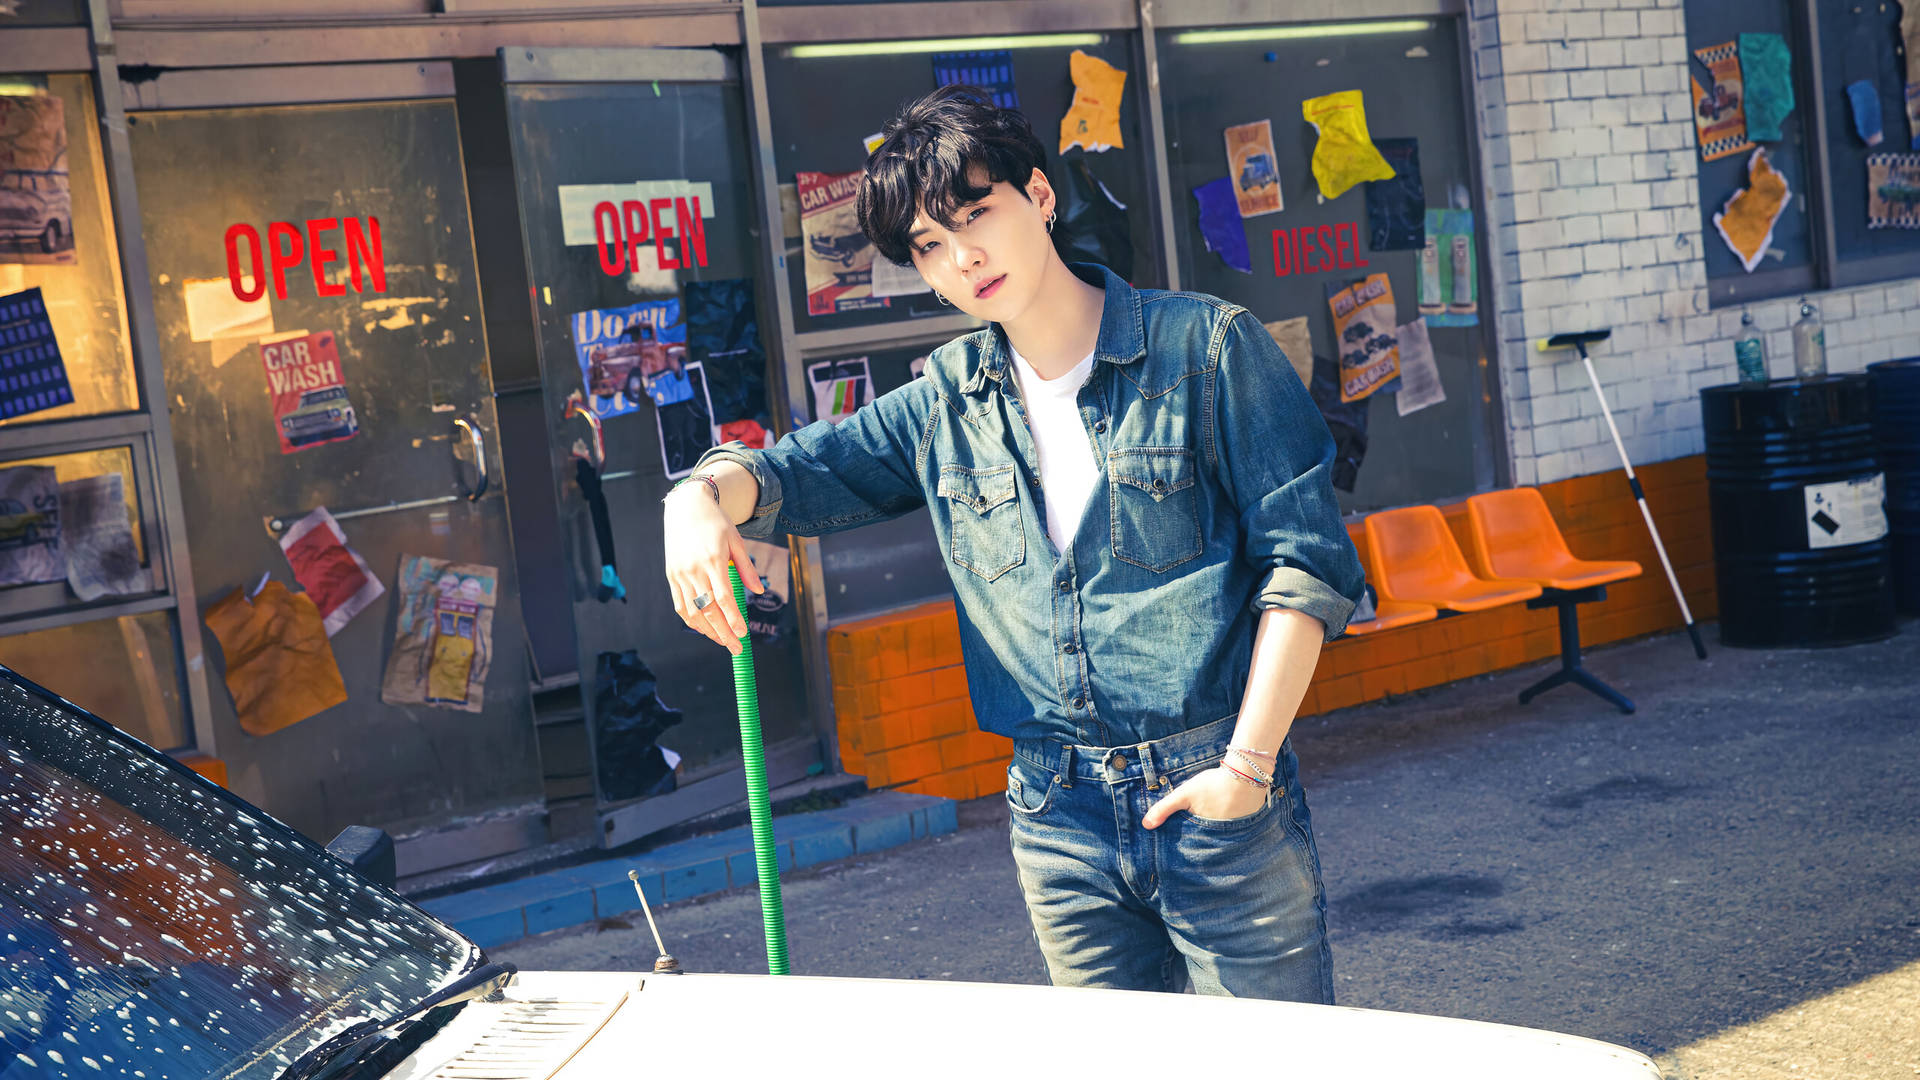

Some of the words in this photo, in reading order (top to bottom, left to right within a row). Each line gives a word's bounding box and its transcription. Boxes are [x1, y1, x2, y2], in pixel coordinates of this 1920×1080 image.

[801, 187, 829, 209] CAR
[828, 172, 862, 199] WAS
[224, 216, 387, 302] OPEN
[594, 196, 709, 276] OPEN
[1272, 222, 1369, 277] DIESEL
[264, 342, 312, 370] CAR
[269, 360, 338, 395] WASH
